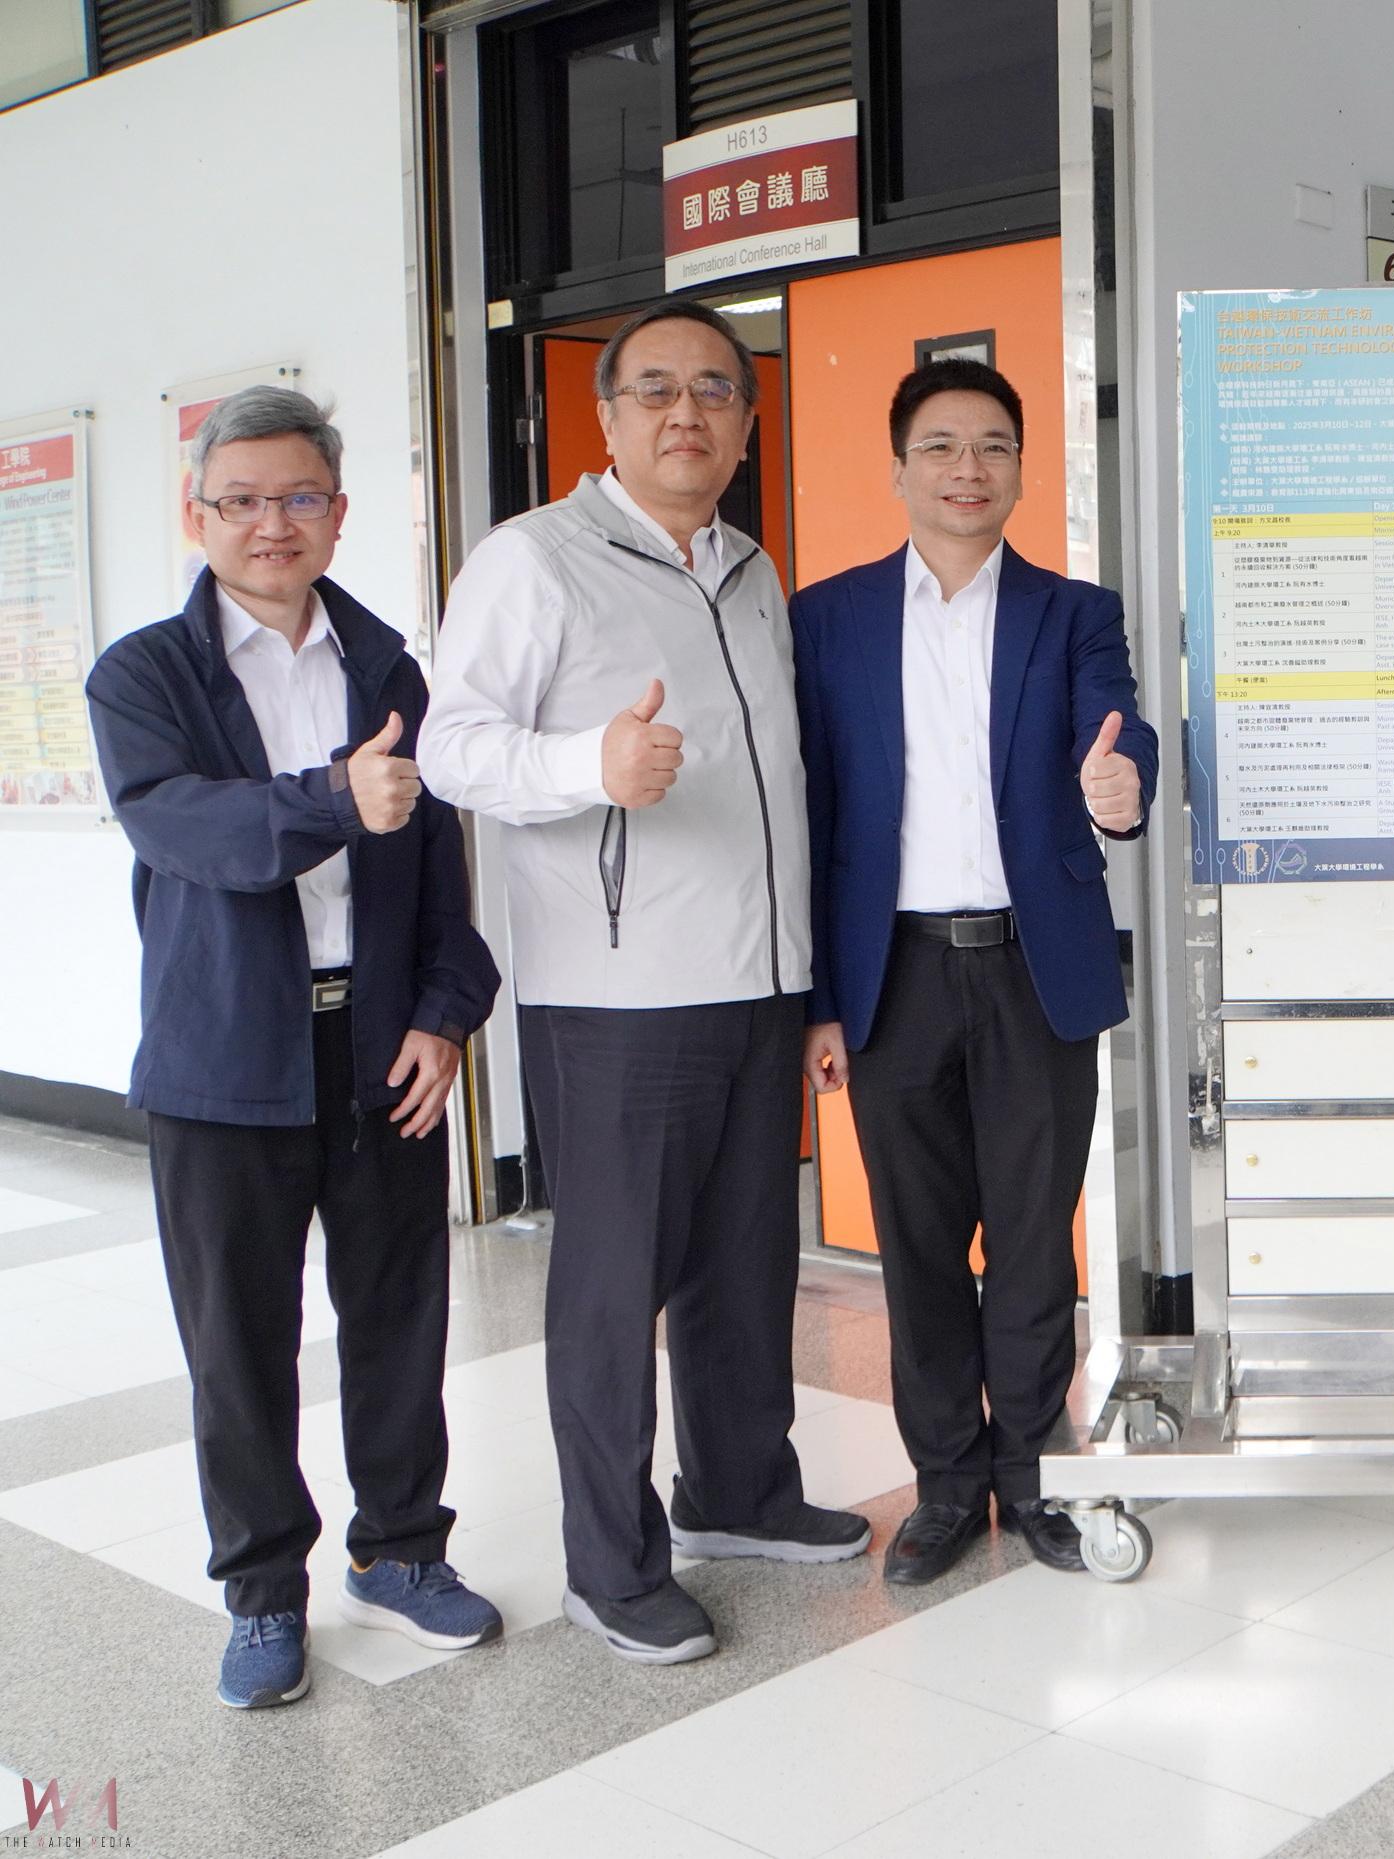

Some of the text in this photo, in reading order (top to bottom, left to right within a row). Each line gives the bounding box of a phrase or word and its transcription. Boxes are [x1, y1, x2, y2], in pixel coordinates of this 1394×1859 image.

[727, 125, 768, 152] H613
[682, 165, 829, 231] 國際會議廳
[682, 235, 828, 278] International Conference Hall
[1218, 326, 1347, 340] TAIWAN-VIETNAM
[1218, 343, 1308, 356] PROTECTION
[1218, 360, 1304, 373] WORKSHOP
[4, 488, 71, 511] Wind Power Center
[1374, 501, 1392, 511] Day
[1213, 504, 1274, 513] 第一天 3月10日
[1214, 529, 1225, 537] 上午
[1376, 674, 1394, 682] Lunch
